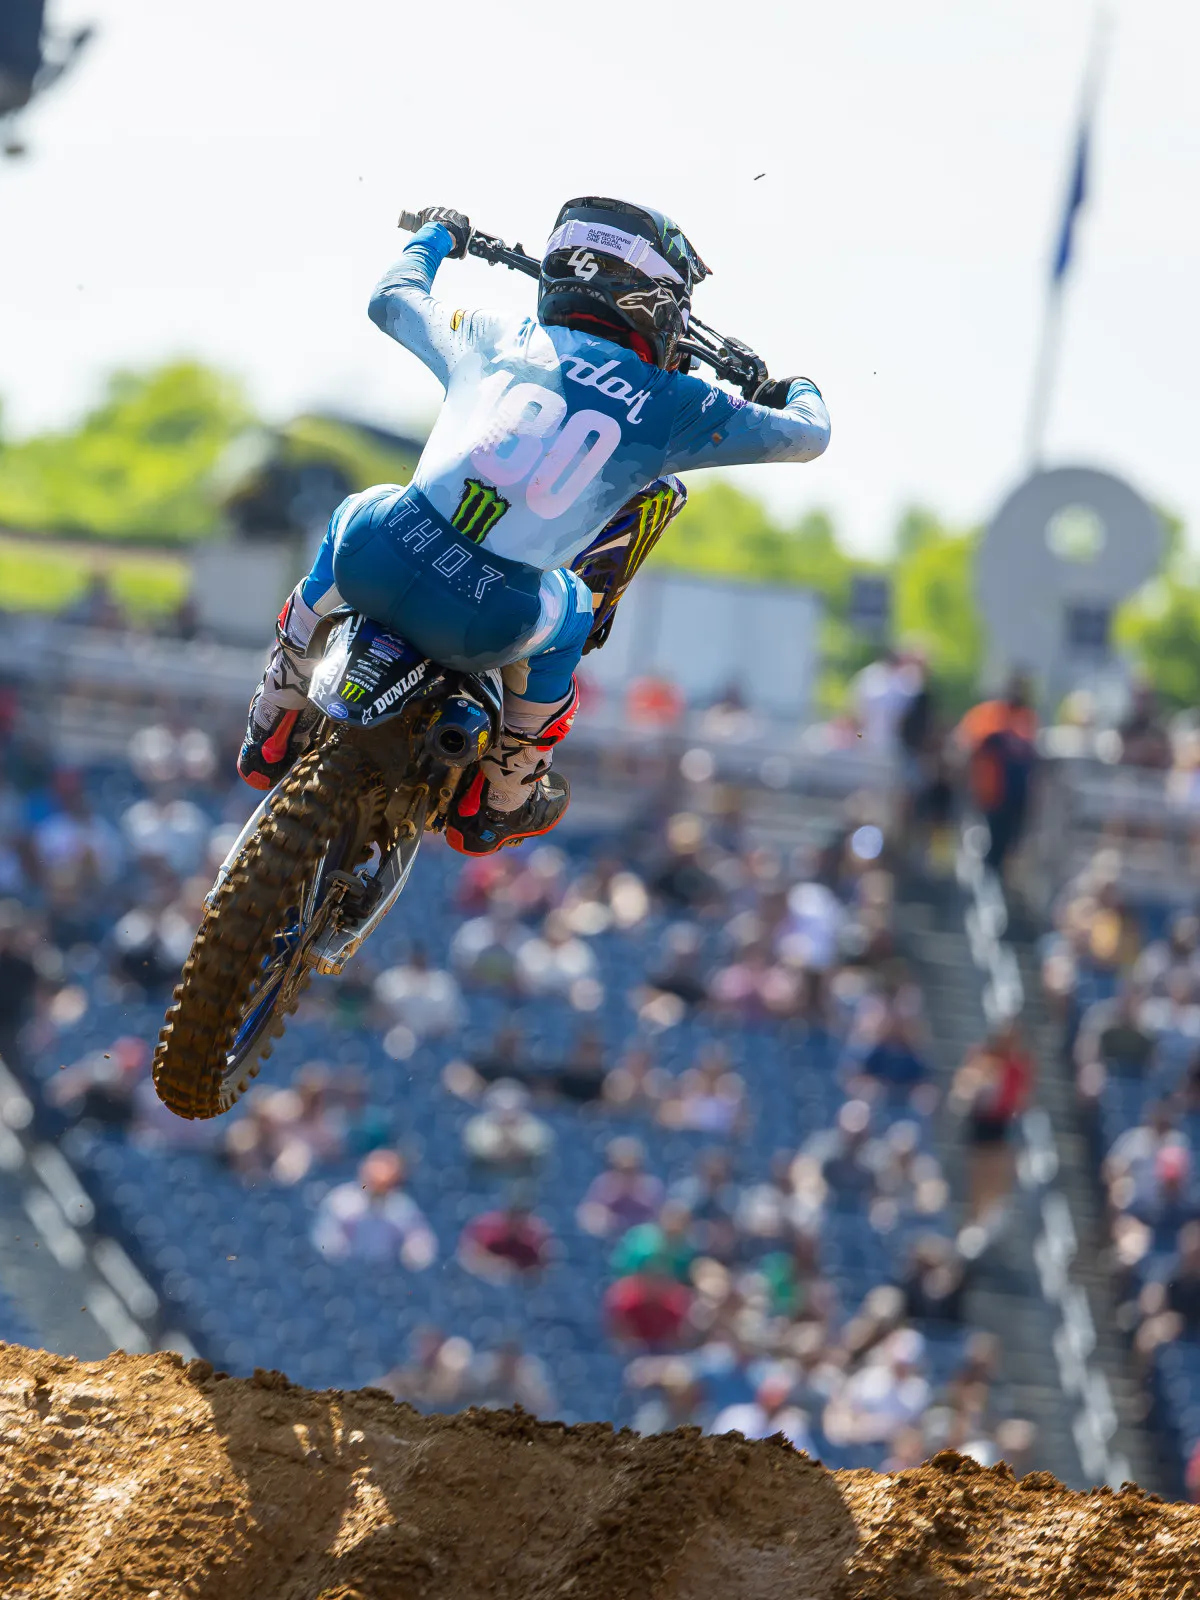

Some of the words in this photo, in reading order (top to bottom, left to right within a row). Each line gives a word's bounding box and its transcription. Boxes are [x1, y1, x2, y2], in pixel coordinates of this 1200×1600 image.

[586, 236, 600, 244] ONE
[600, 240, 623, 251] VISION.
[587, 232, 600, 241] ONE
[588, 228, 632, 245] ALPINESTARS
[345, 673, 374, 693] YAMAHA
[373, 663, 427, 715] DUNLOP
